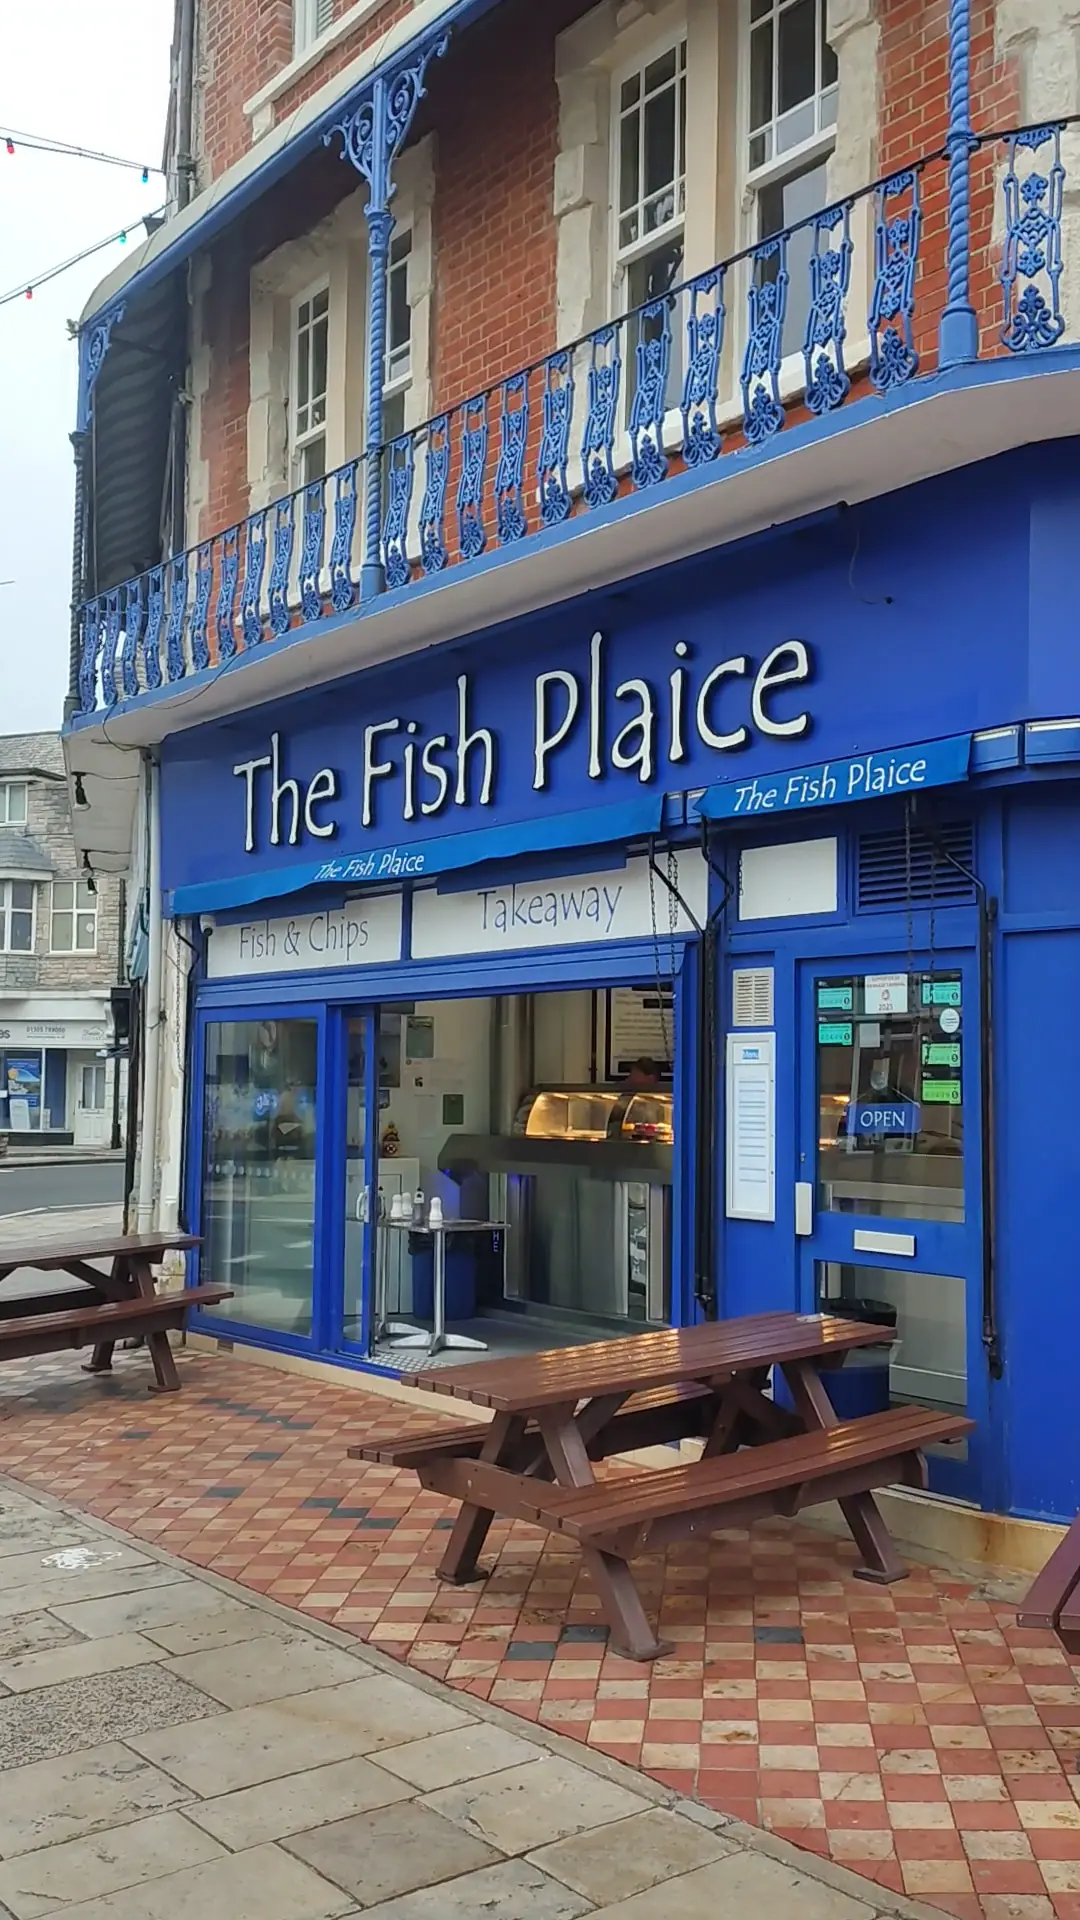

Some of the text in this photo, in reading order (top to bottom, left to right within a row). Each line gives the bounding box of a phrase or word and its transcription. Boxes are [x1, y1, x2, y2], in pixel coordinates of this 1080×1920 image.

[233, 631, 810, 852] The Fish Plaice
[734, 757, 927, 812] The Fish Plaice
[314, 848, 425, 880] The Fish Plaice
[477, 882, 623, 935] Takeaway
[239, 910, 370, 962] Fish & Chips
[860, 1110, 905, 1127] OPEN
